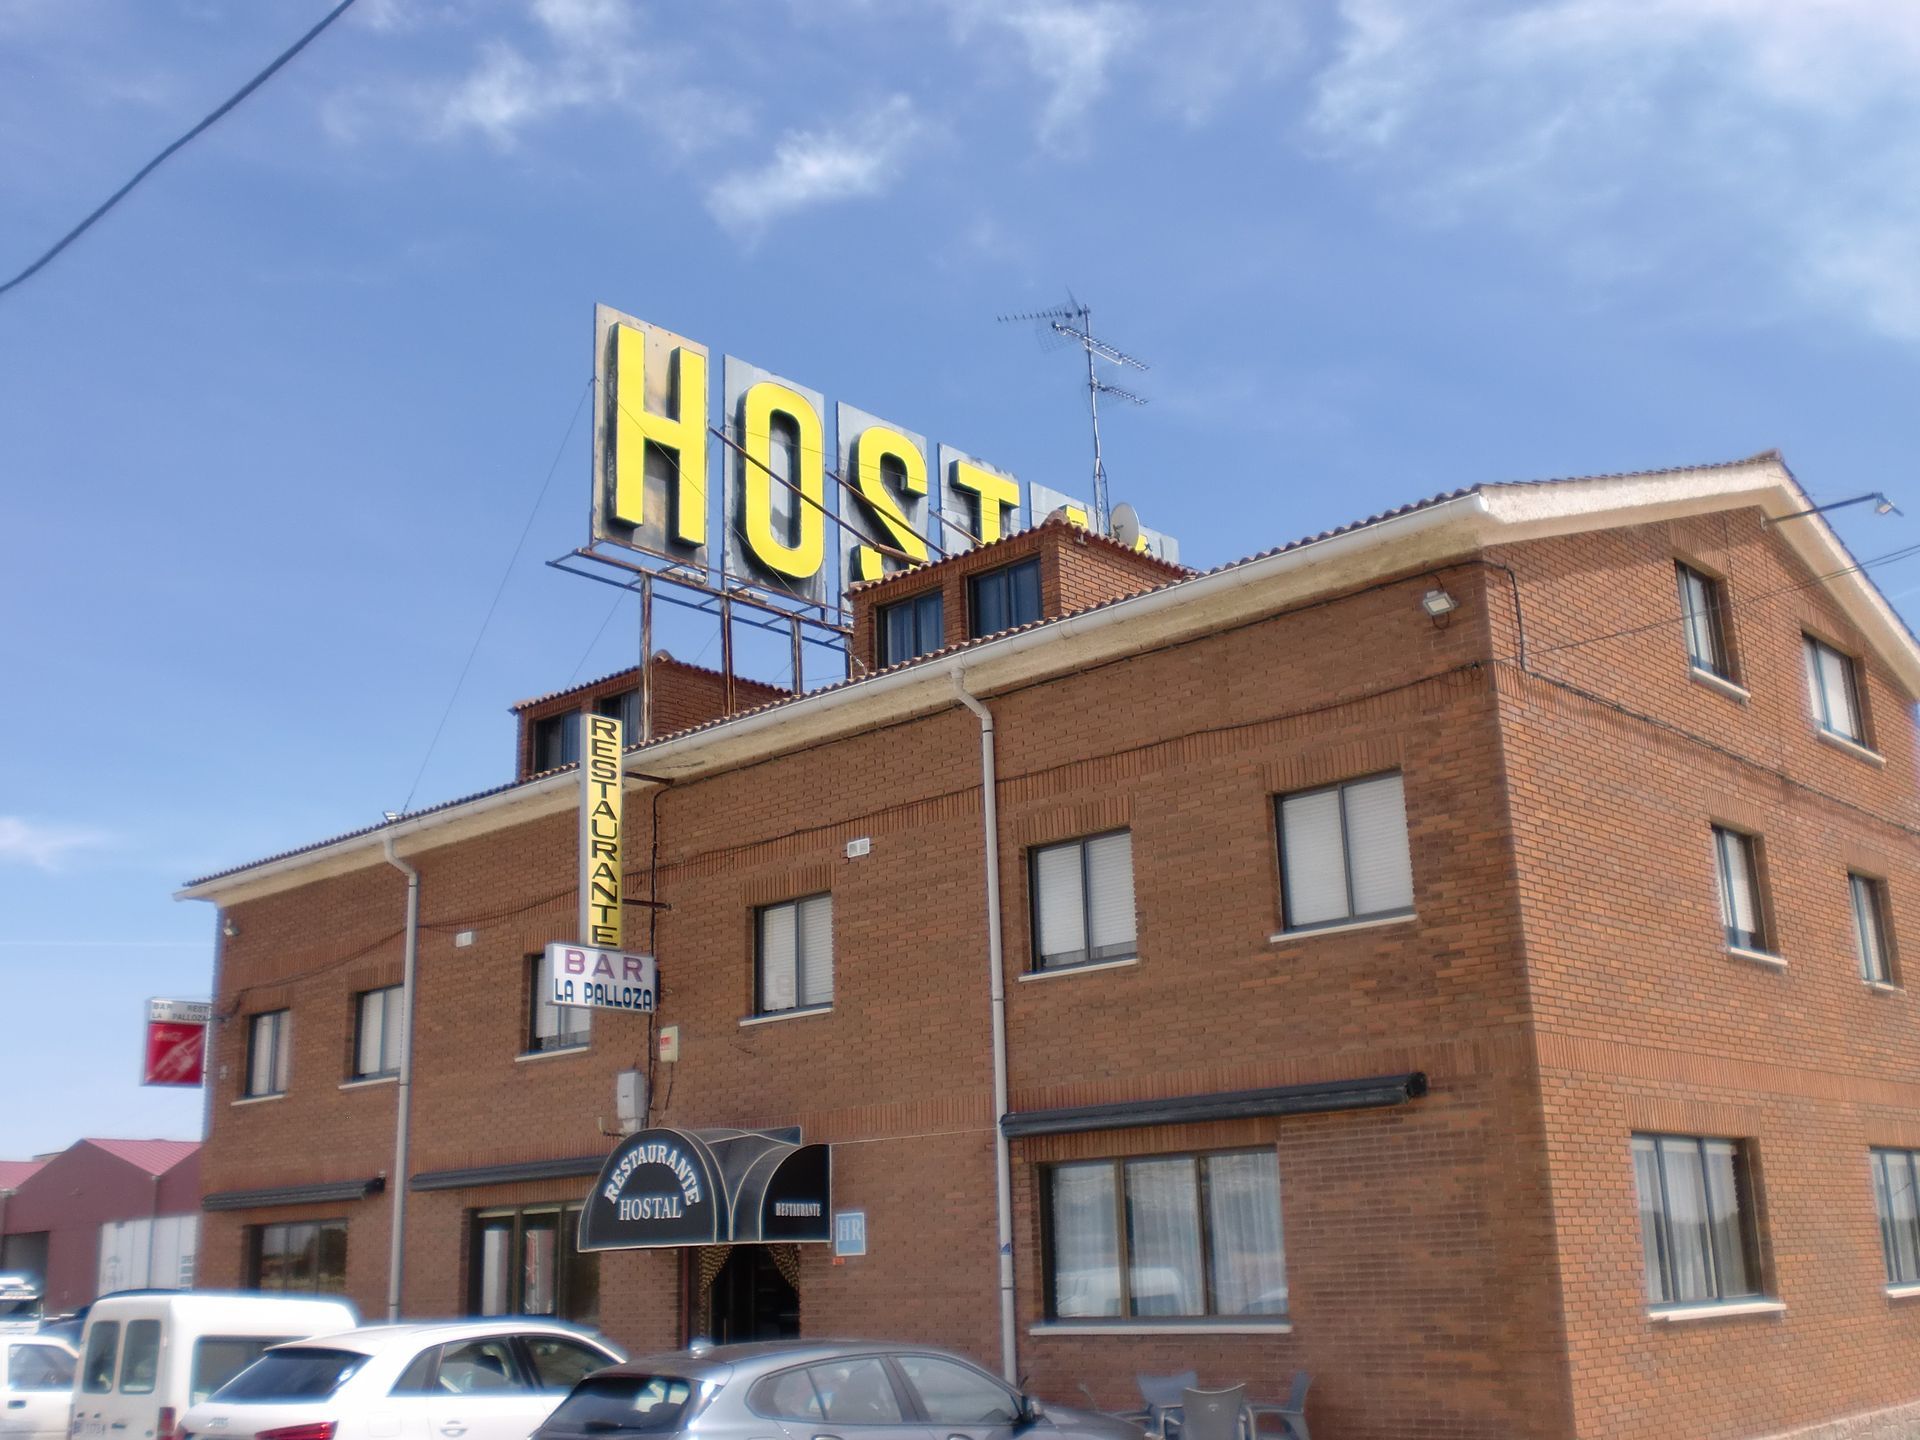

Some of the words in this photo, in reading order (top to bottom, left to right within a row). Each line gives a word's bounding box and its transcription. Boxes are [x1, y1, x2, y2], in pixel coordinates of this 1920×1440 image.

[611, 322, 1150, 582] HOST
[591, 717, 618, 946] RESTAURANTE
[565, 949, 643, 982] BAR
[554, 978, 574, 1002] LA
[584, 983, 652, 1010] PALLOZA
[172, 1013, 207, 1021] PALLOZA
[604, 1144, 700, 1206] RESTAURANTE
[619, 1196, 682, 1221] HOSTAL
[775, 1202, 821, 1217] RESTAURANTE
[838, 1219, 861, 1241] HR
